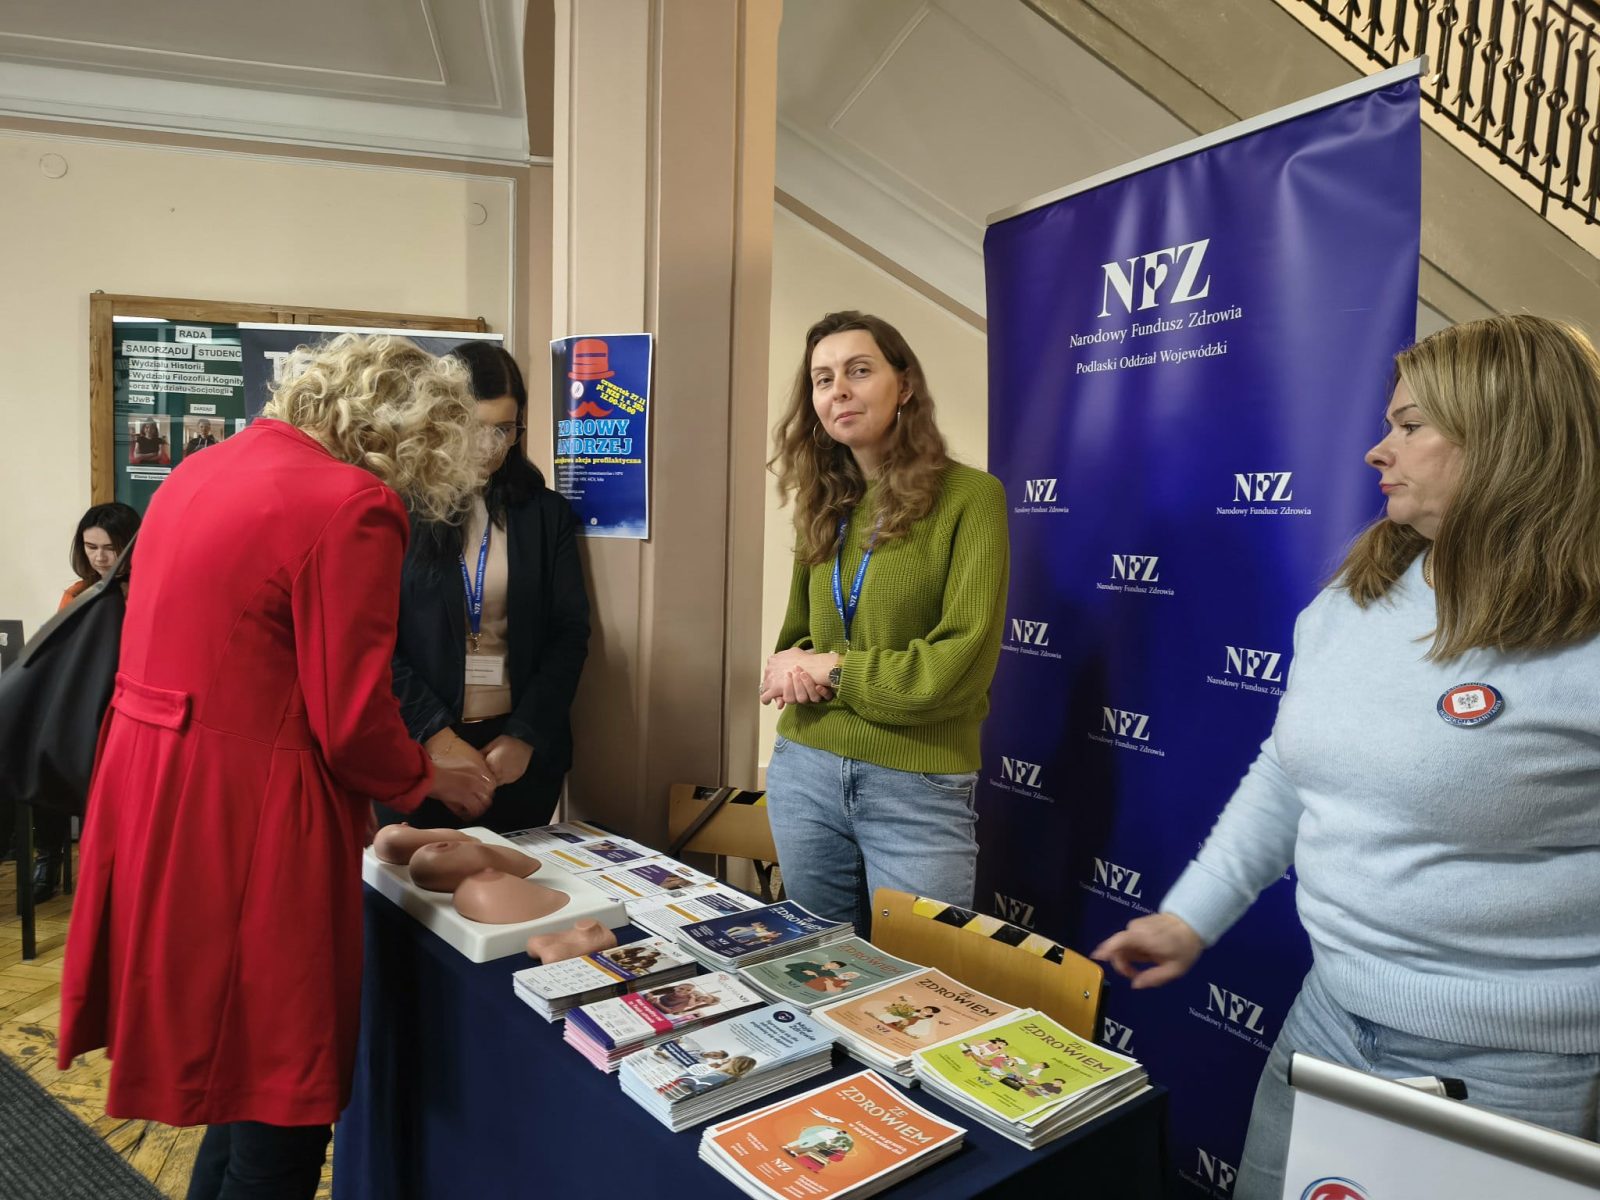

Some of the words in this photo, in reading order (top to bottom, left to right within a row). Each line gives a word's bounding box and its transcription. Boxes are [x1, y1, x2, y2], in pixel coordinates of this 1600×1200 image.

[1097, 238, 1211, 318] NFZ
[179, 330, 207, 339] RADA
[1070, 328, 1127, 348] Narodowy
[1131, 317, 1183, 337] Fundusz
[1188, 304, 1242, 328] Zdrowia
[126, 344, 188, 356] SAMORZĄDU
[1076, 357, 1117, 374] Podlaski
[1119, 352, 1156, 369] Oddział
[1160, 340, 1227, 365] Wojewódzki
[1023, 478, 1057, 503] NFZ
[1232, 472, 1292, 502] NFZ
[1216, 507, 1249, 516] Narodowy
[1250, 506, 1278, 514] Fundusz
[1280, 506, 1312, 515] Zdrowia
[1110, 554, 1159, 582] NFZ
[1096, 582, 1122, 592] Narodowy
[1124, 584, 1148, 593] Fundusz
[1148, 586, 1174, 596] Zdrowia
[1010, 618, 1048, 646] NFZ
[1040, 650, 1062, 659] Zdrowia
[1224, 646, 1282, 682] NFZ
[1206, 676, 1240, 690] Narodowy
[1241, 681, 1268, 694] Fundusz
[1101, 706, 1150, 741] NFZ
[1115, 739, 1138, 750] Fundusz
[1140, 744, 1165, 756] Zdrowia
[1000, 756, 1042, 788] NFZ
[1093, 856, 1142, 898] NFZ
[994, 892, 1035, 929] NFZ
[1106, 892, 1130, 906] Fundusz
[919, 977, 1000, 1018] ZDROWIEM
[1206, 982, 1264, 1035] NFZ
[1104, 1016, 1134, 1054] FZ
[1188, 1006, 1222, 1030] Narodowy
[1224, 1023, 1252, 1042] Fundusz
[1023, 1023, 1116, 1074] ZDROWIEM
[1068, 1041, 1086, 1052] ZE
[840, 1086, 934, 1144] ZDROWIEM
[889, 1106, 908, 1118] ZE
[771, 1158, 794, 1172] NFZ
[1196, 1146, 1237, 1192] NF
